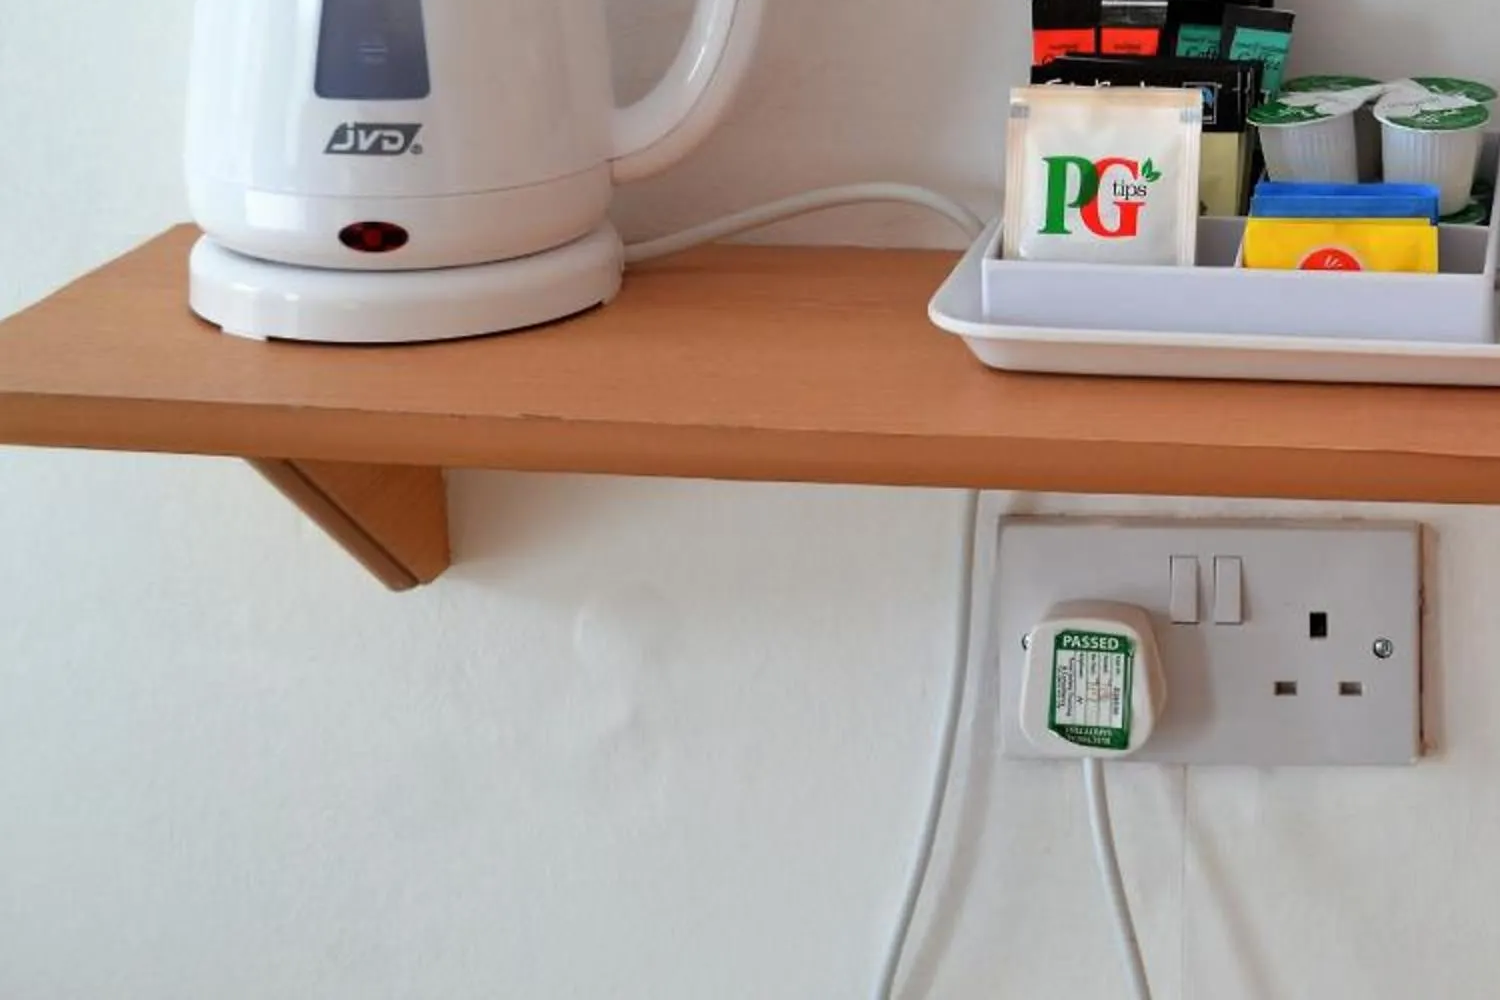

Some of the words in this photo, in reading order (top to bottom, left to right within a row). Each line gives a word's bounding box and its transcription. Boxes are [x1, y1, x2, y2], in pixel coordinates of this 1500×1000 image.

[1037, 156, 1145, 238] PG
[1112, 179, 1148, 200] tips
[1062, 635, 1120, 651] PASSED
